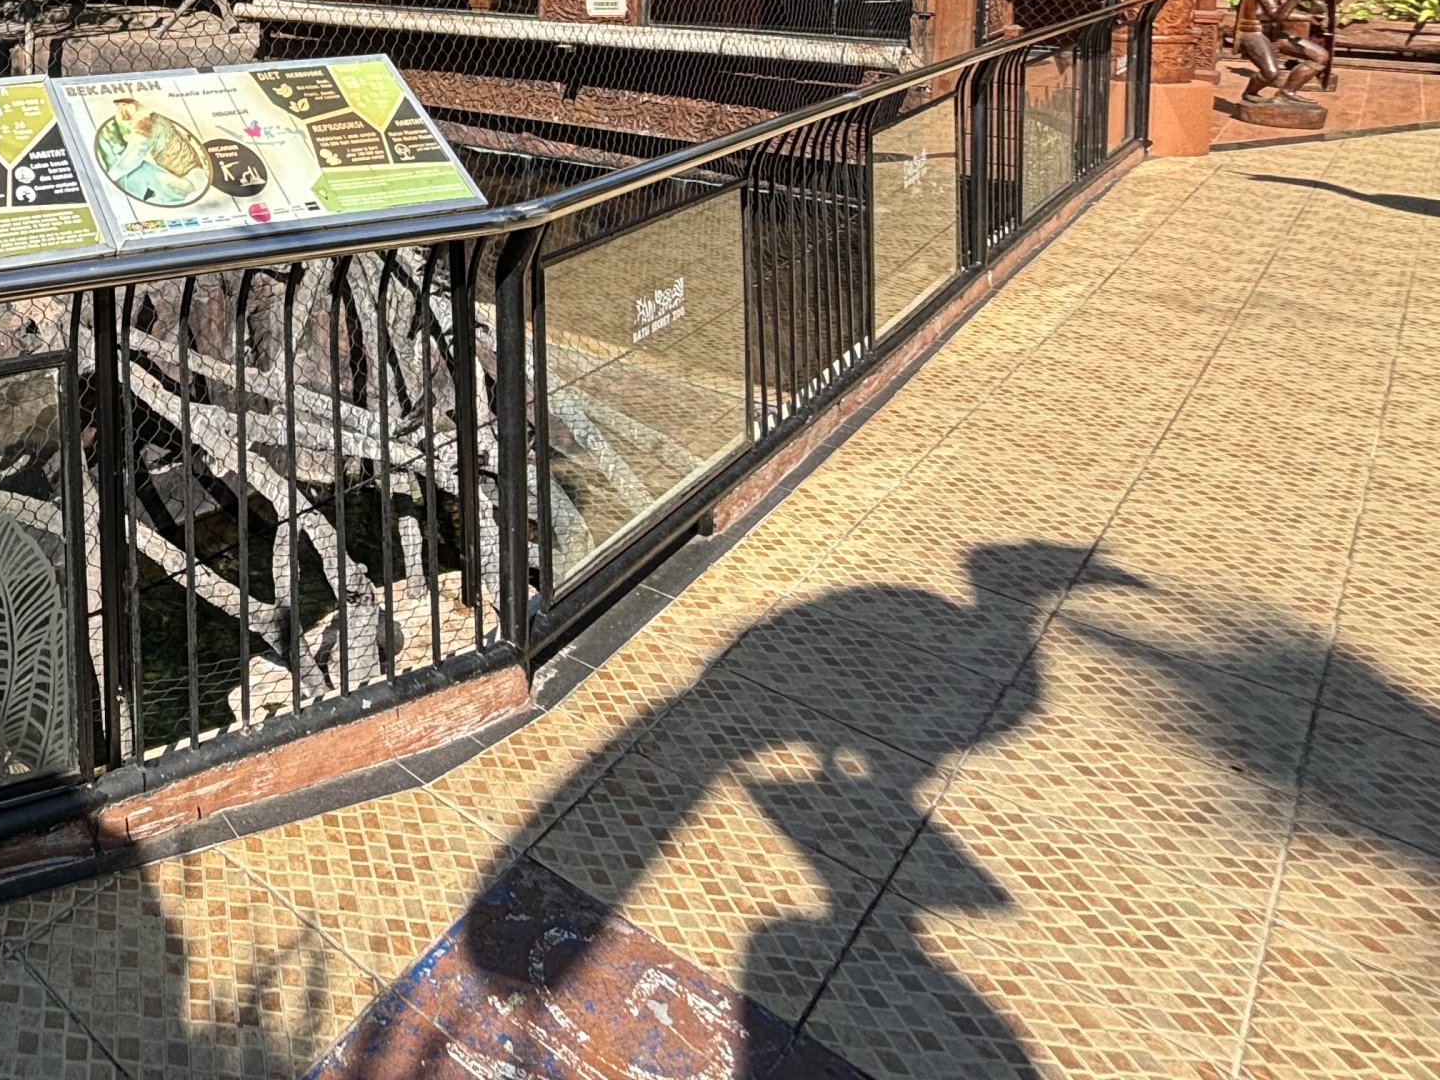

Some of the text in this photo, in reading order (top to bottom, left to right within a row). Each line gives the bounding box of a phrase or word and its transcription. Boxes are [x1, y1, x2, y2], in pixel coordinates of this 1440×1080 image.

[256, 71, 281, 81] DIET
[66, 80, 162, 97] BEKANTAN
[312, 121, 364, 133] REPRODUKSI
[29, 149, 66, 160] HABITAT
[632, 324, 650, 344] BATU
[651, 314, 670, 333] SECRET
